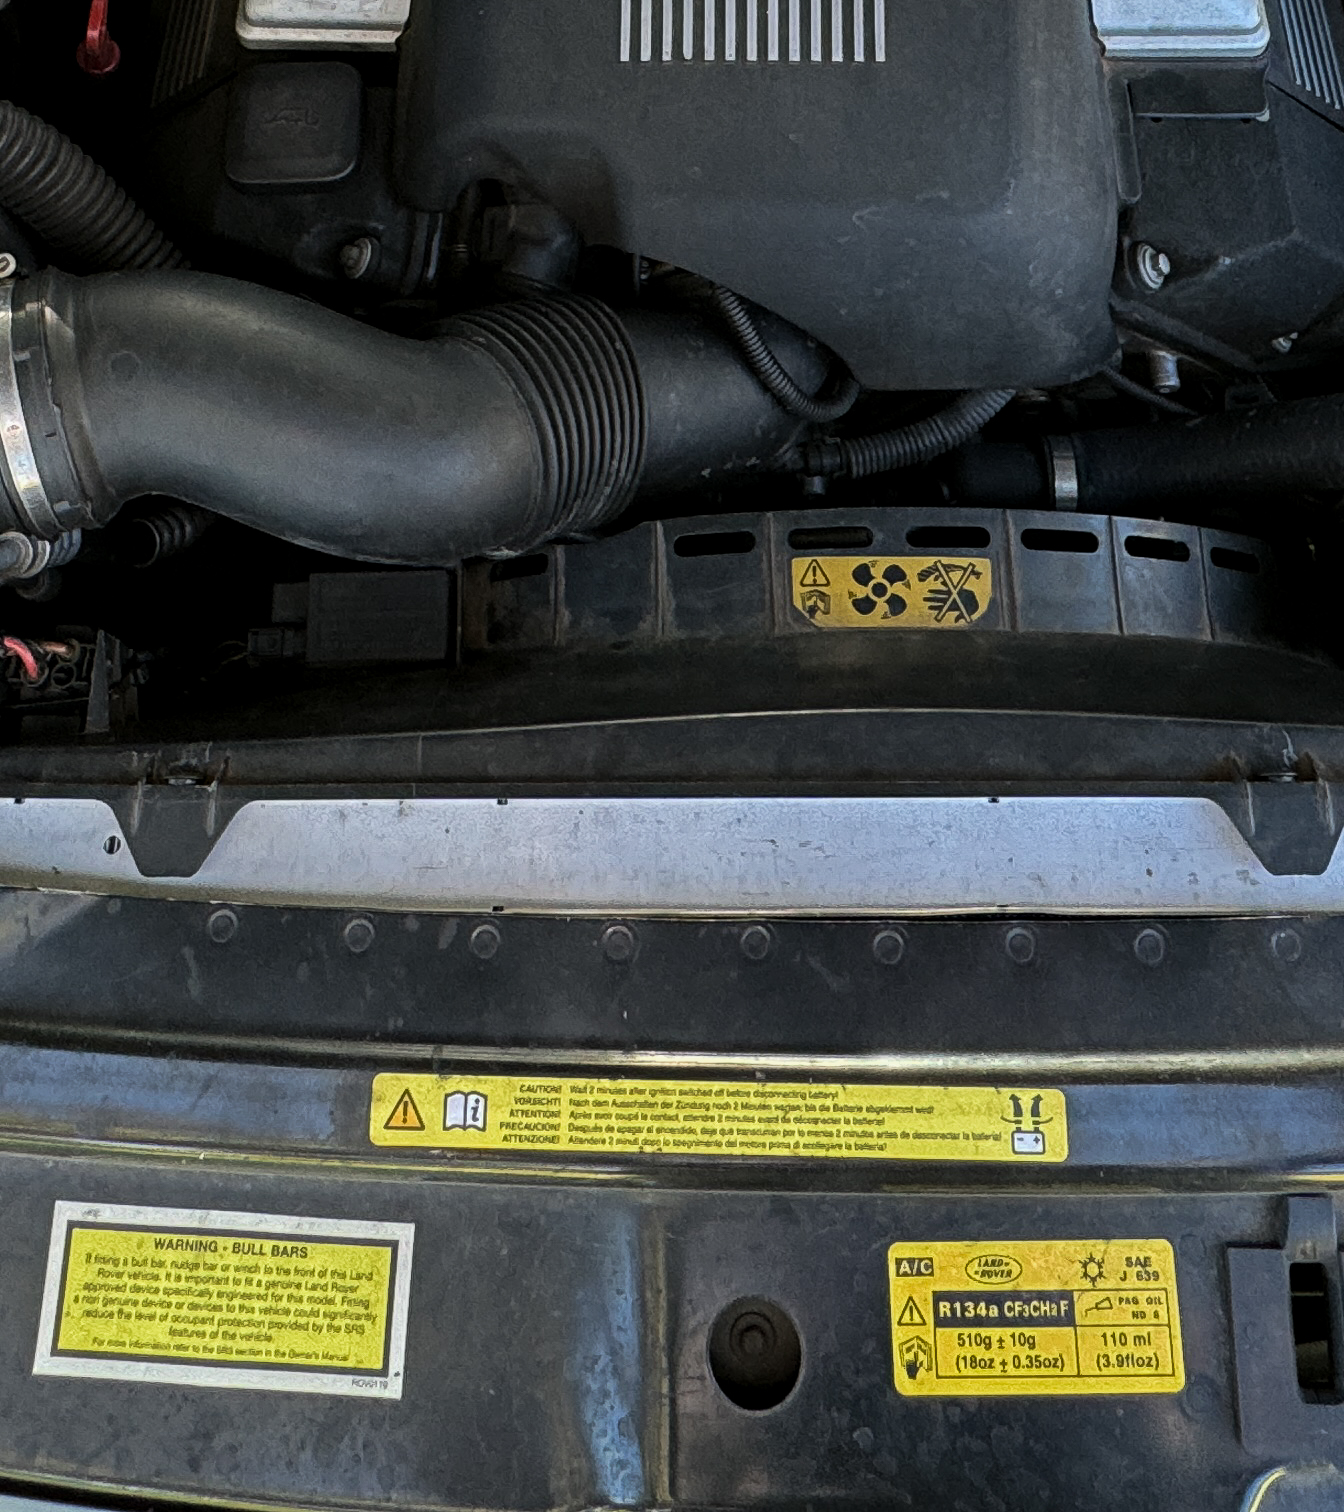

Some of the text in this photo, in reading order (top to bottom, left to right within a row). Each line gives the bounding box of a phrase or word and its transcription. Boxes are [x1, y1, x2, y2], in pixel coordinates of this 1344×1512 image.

[589, 1086, 595, 1094] 2
[608, 1137, 613, 1145] 2
[154, 1238, 217, 1252] WARNING
[232, 1243, 266, 1255] BULL
[271, 1245, 308, 1257] BARS
[899, 1260, 932, 1275] A/C
[1125, 1256, 1152, 1268] SAE
[203, 1261, 218, 1271] bar
[318, 1268, 327, 1278] of
[349, 1269, 373, 1280] Land
[1119, 1271, 1127, 1281] J
[98, 1269, 124, 1279] Rover
[185, 1273, 229, 1285] important
[305, 1281, 328, 1291] Land
[83, 1282, 127, 1292] approved
[129, 1284, 160, 1294] device
[271, 1291, 283, 1302] for
[1119, 1296, 1163, 1305] PAG OIL
[293, 1308, 320, 1318] could
[939, 1301, 999, 1318] R134a
[83, 1309, 114, 1319] reduce
[159, 1313, 168, 1322] of
[171, 1315, 214, 1325] occupant
[312, 1322, 323, 1334] by
[209, 1328, 219, 1338] of
[958, 1333, 992, 1350] 510g
[1010, 1332, 1035, 1350] 10g
[1101, 1331, 1151, 1347] 110 ml
[956, 1355, 995, 1372] (18oz
[1013, 1353, 1064, 1371] 0.35oz)
